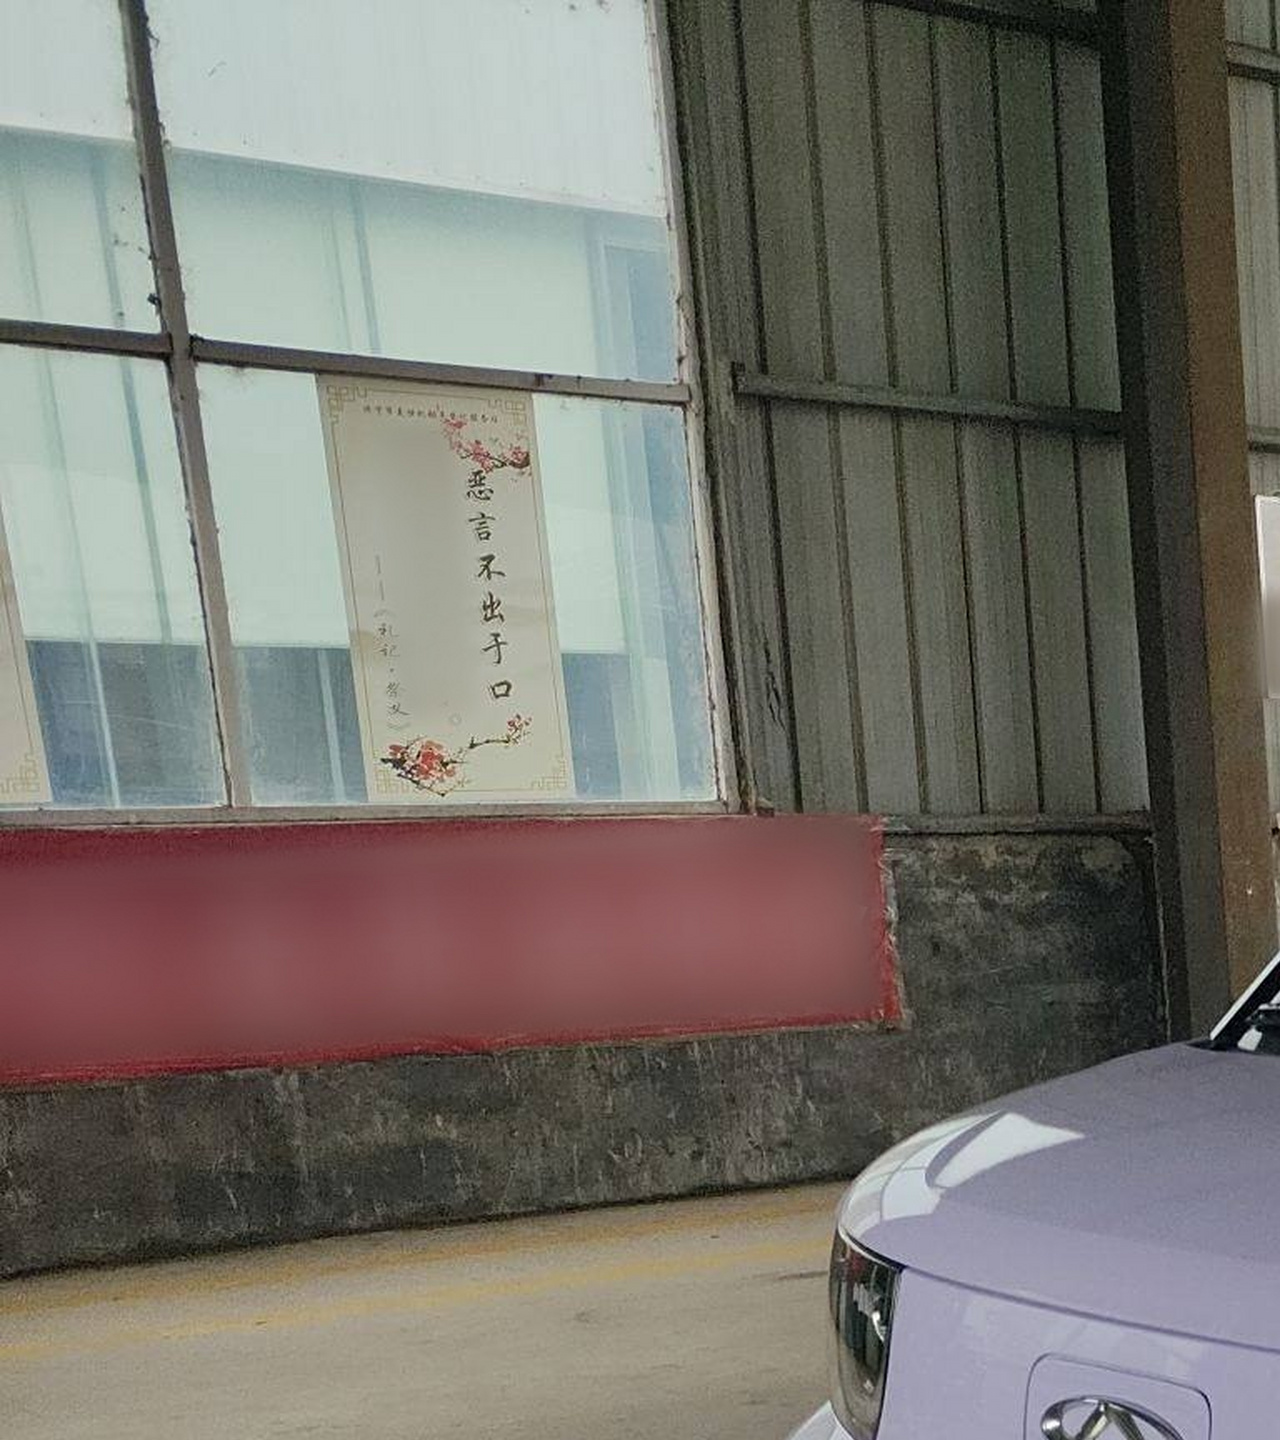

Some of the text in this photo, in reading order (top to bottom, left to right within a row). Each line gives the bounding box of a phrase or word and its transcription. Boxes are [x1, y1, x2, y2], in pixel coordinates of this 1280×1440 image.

[467, 470, 512, 699] 恶言不出于口
